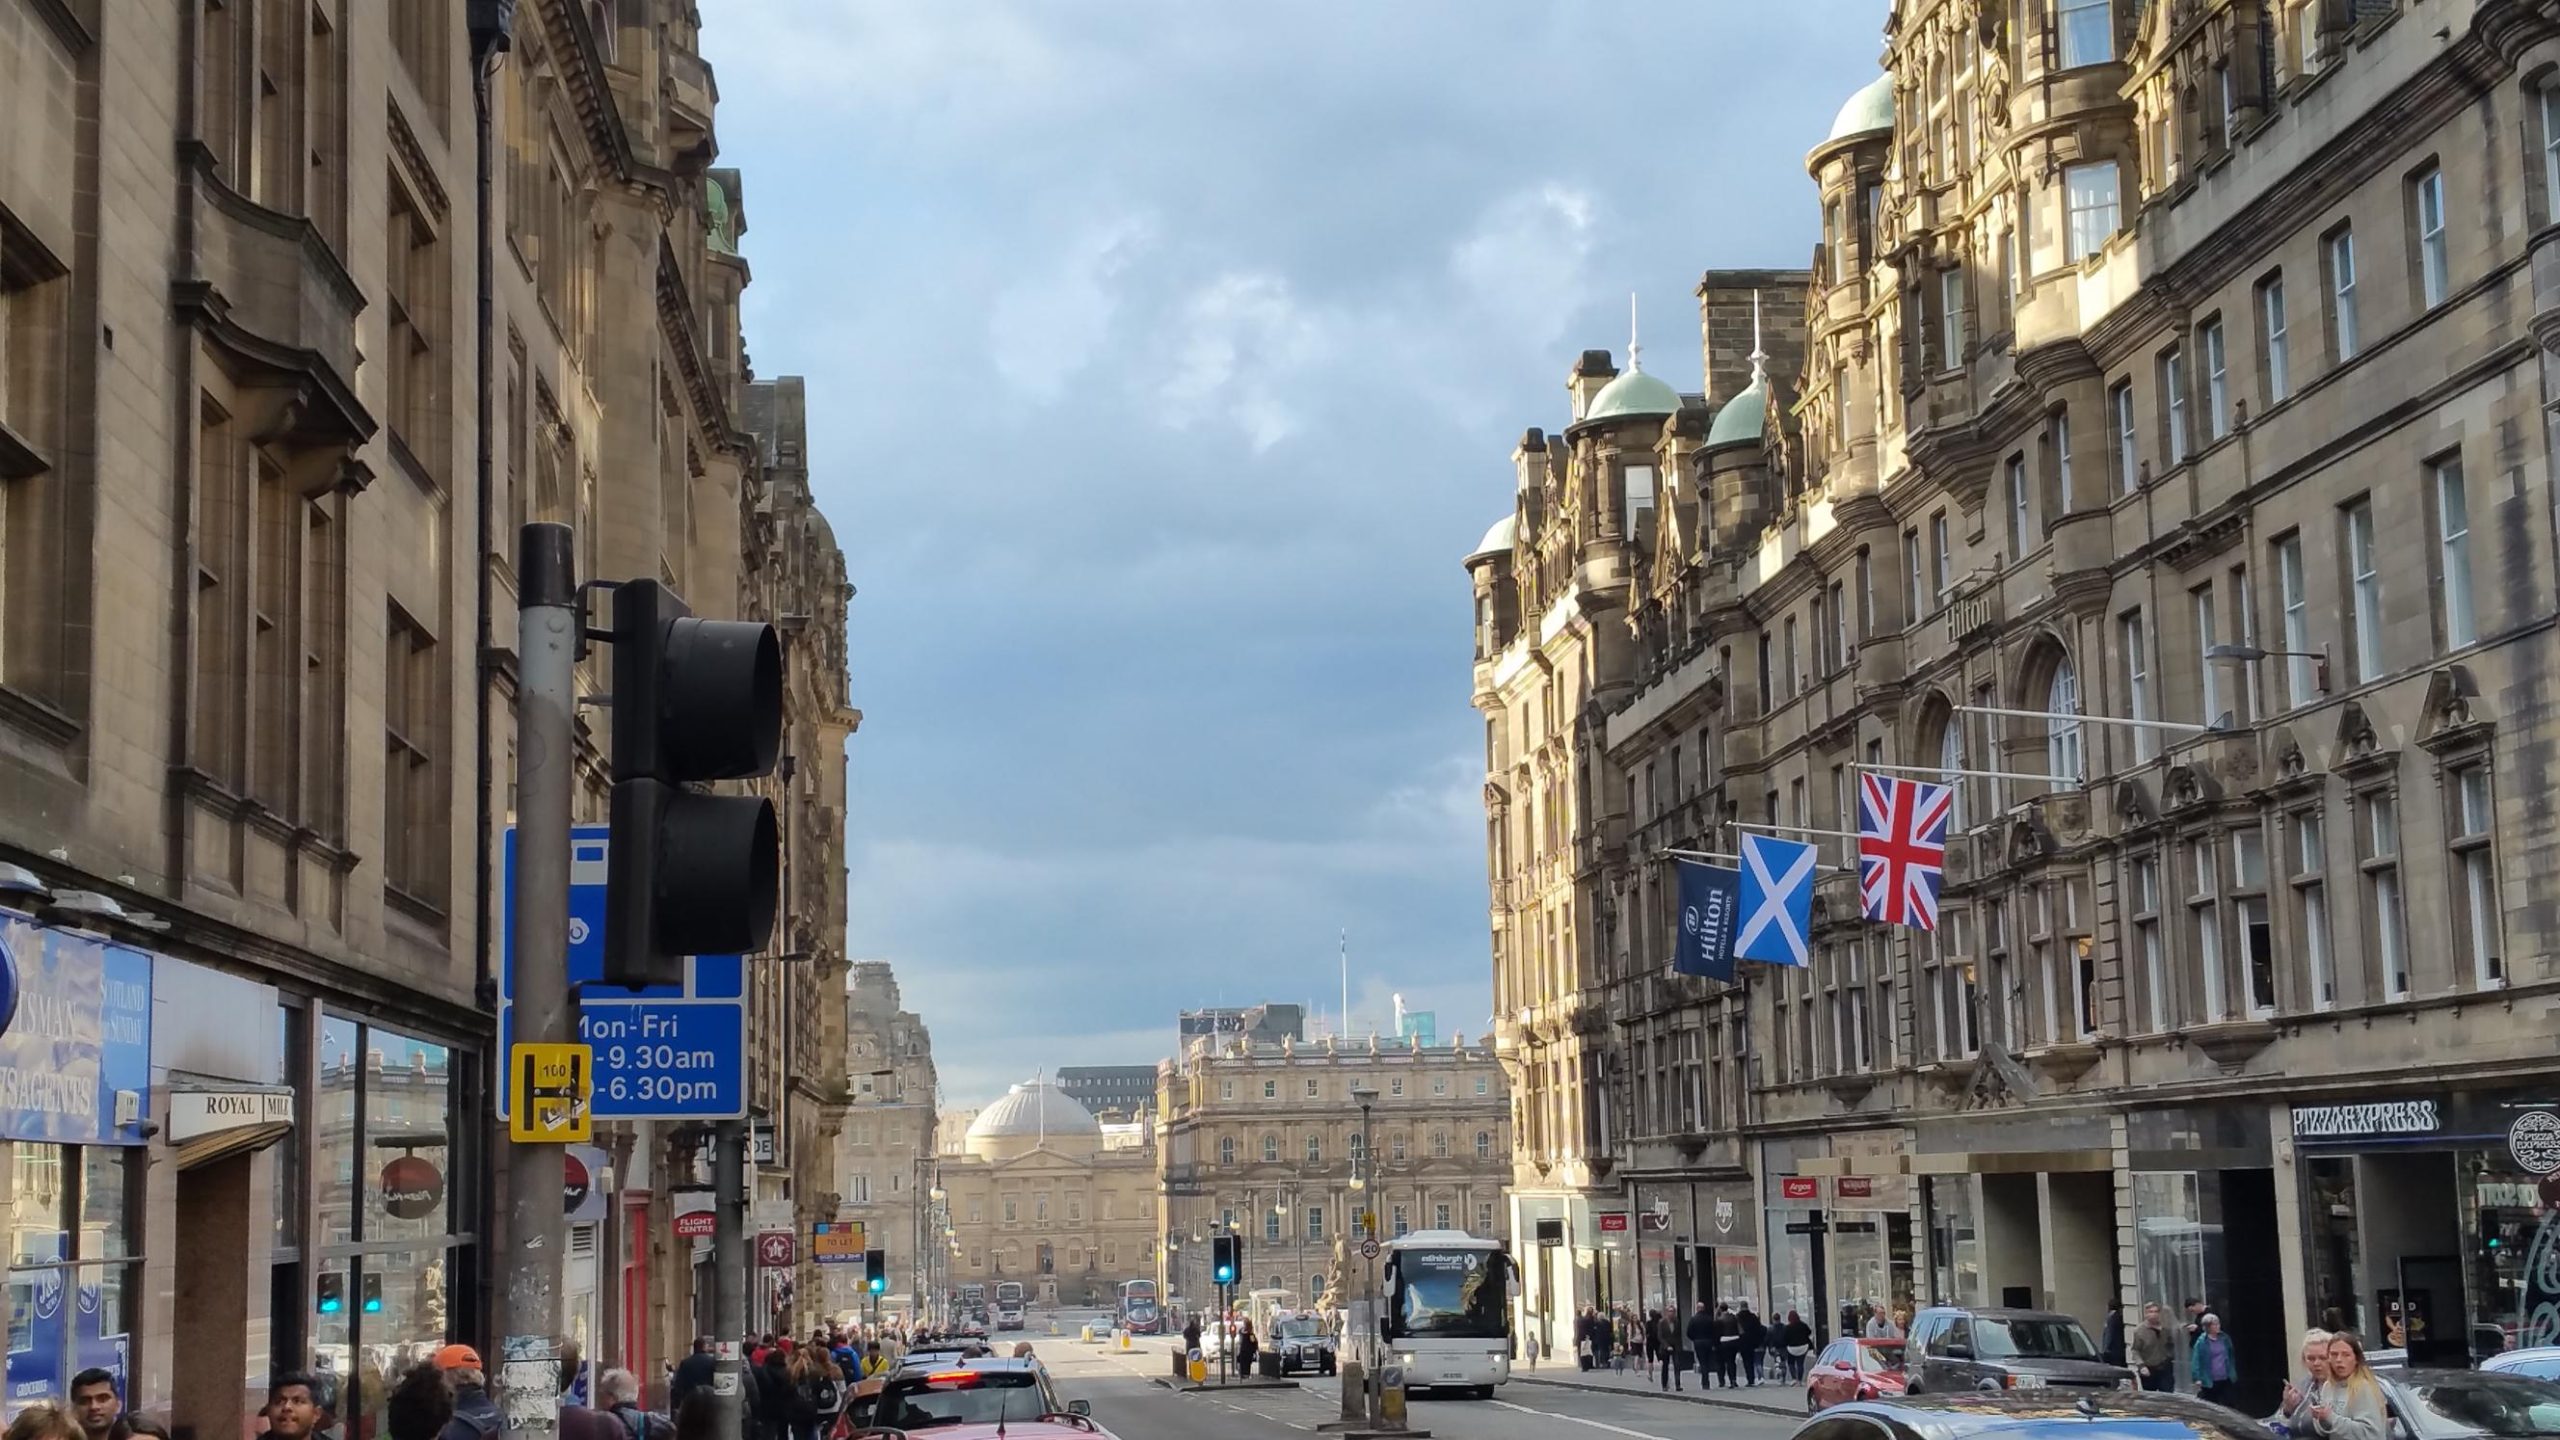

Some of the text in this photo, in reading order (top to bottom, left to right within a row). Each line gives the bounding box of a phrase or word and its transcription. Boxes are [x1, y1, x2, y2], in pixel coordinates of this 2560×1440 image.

[1945, 597, 1991, 644] Hilton
[1701, 889, 1723, 961] Hilton
[17, 991, 77, 1041] TSMAN
[596, 1045, 715, 1070] -9.30am
[590, 1075, 717, 1104] -6.30pm
[206, 1096, 289, 1116] ROYAL MILE
[2524, 1133, 2555, 1142] PIZZA
[1789, 1183, 1812, 1192] Argos
[1655, 1196, 1669, 1221] Argos
[1715, 1197, 1733, 1223] Argos
[678, 1225, 714, 1234] CENTRE
[679, 1217, 713, 1226] FLIGHT
[1364, 1244, 1378, 1254] 20
